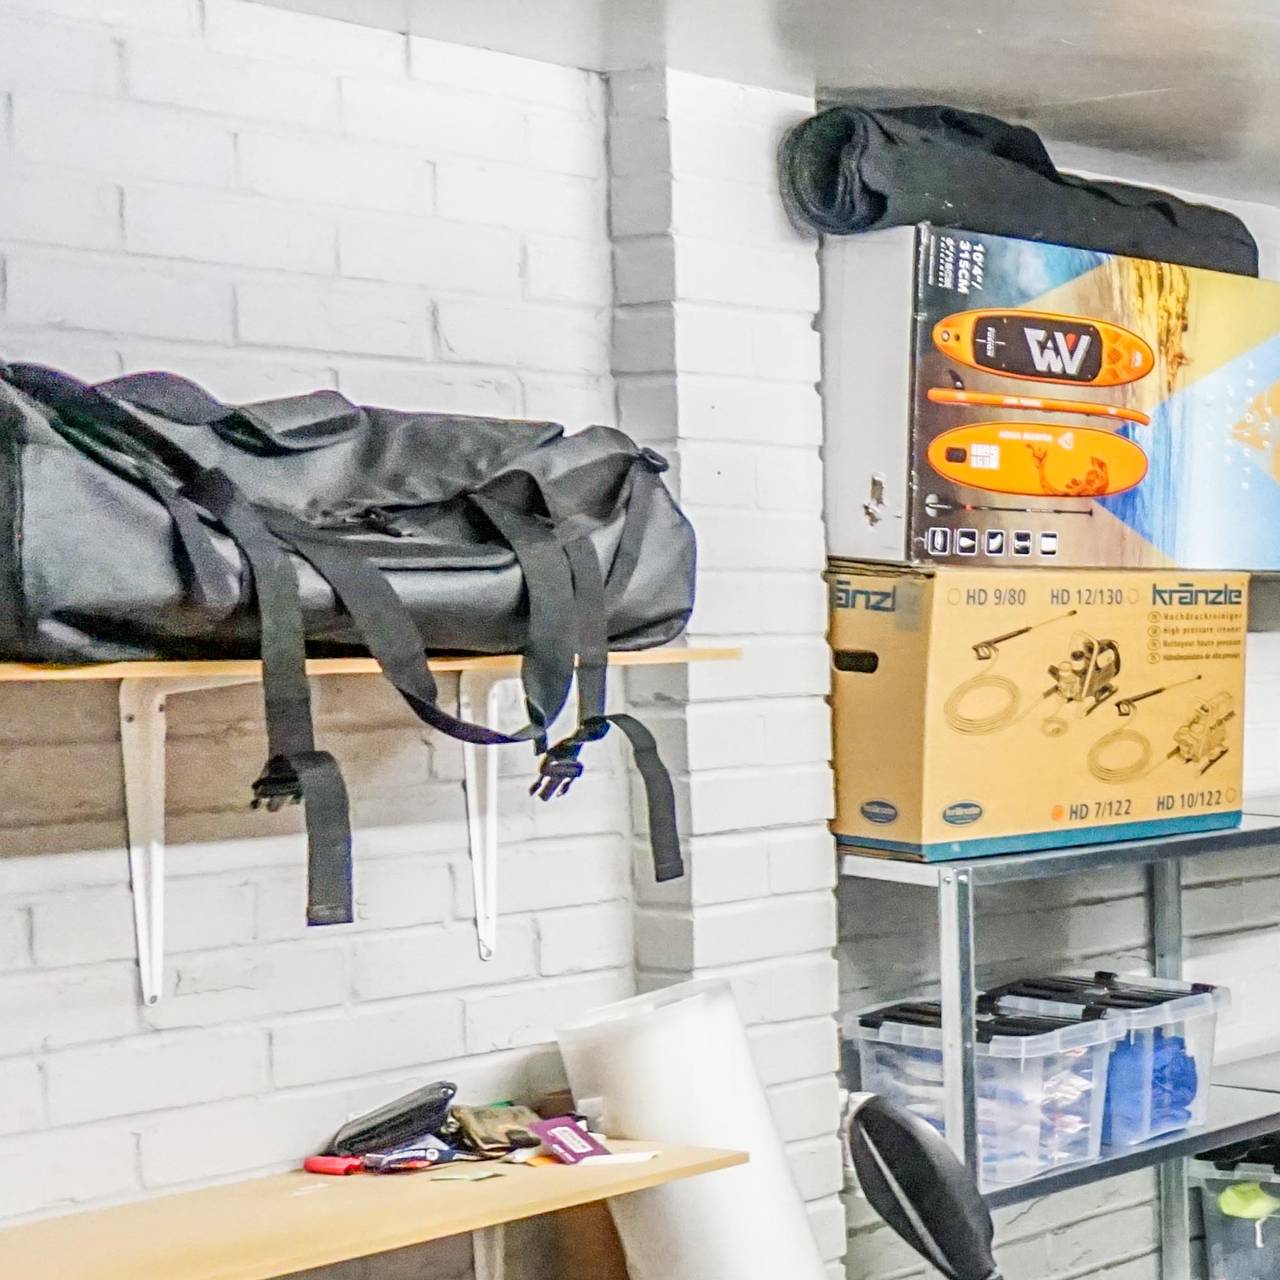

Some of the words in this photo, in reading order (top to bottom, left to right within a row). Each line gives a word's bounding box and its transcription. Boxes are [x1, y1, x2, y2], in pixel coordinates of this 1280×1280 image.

[957, 240, 973, 295] 315CM
[966, 588, 988, 605] HD
[993, 588, 1027, 606] 9/80
[1051, 588, 1071, 605] HD
[1076, 588, 1123, 605] 12/130
[1069, 804, 1089, 820] HD
[1095, 799, 1132, 818] 7/122
[1157, 795, 1175, 812] HD
[1180, 789, 1222, 809] 10/122
